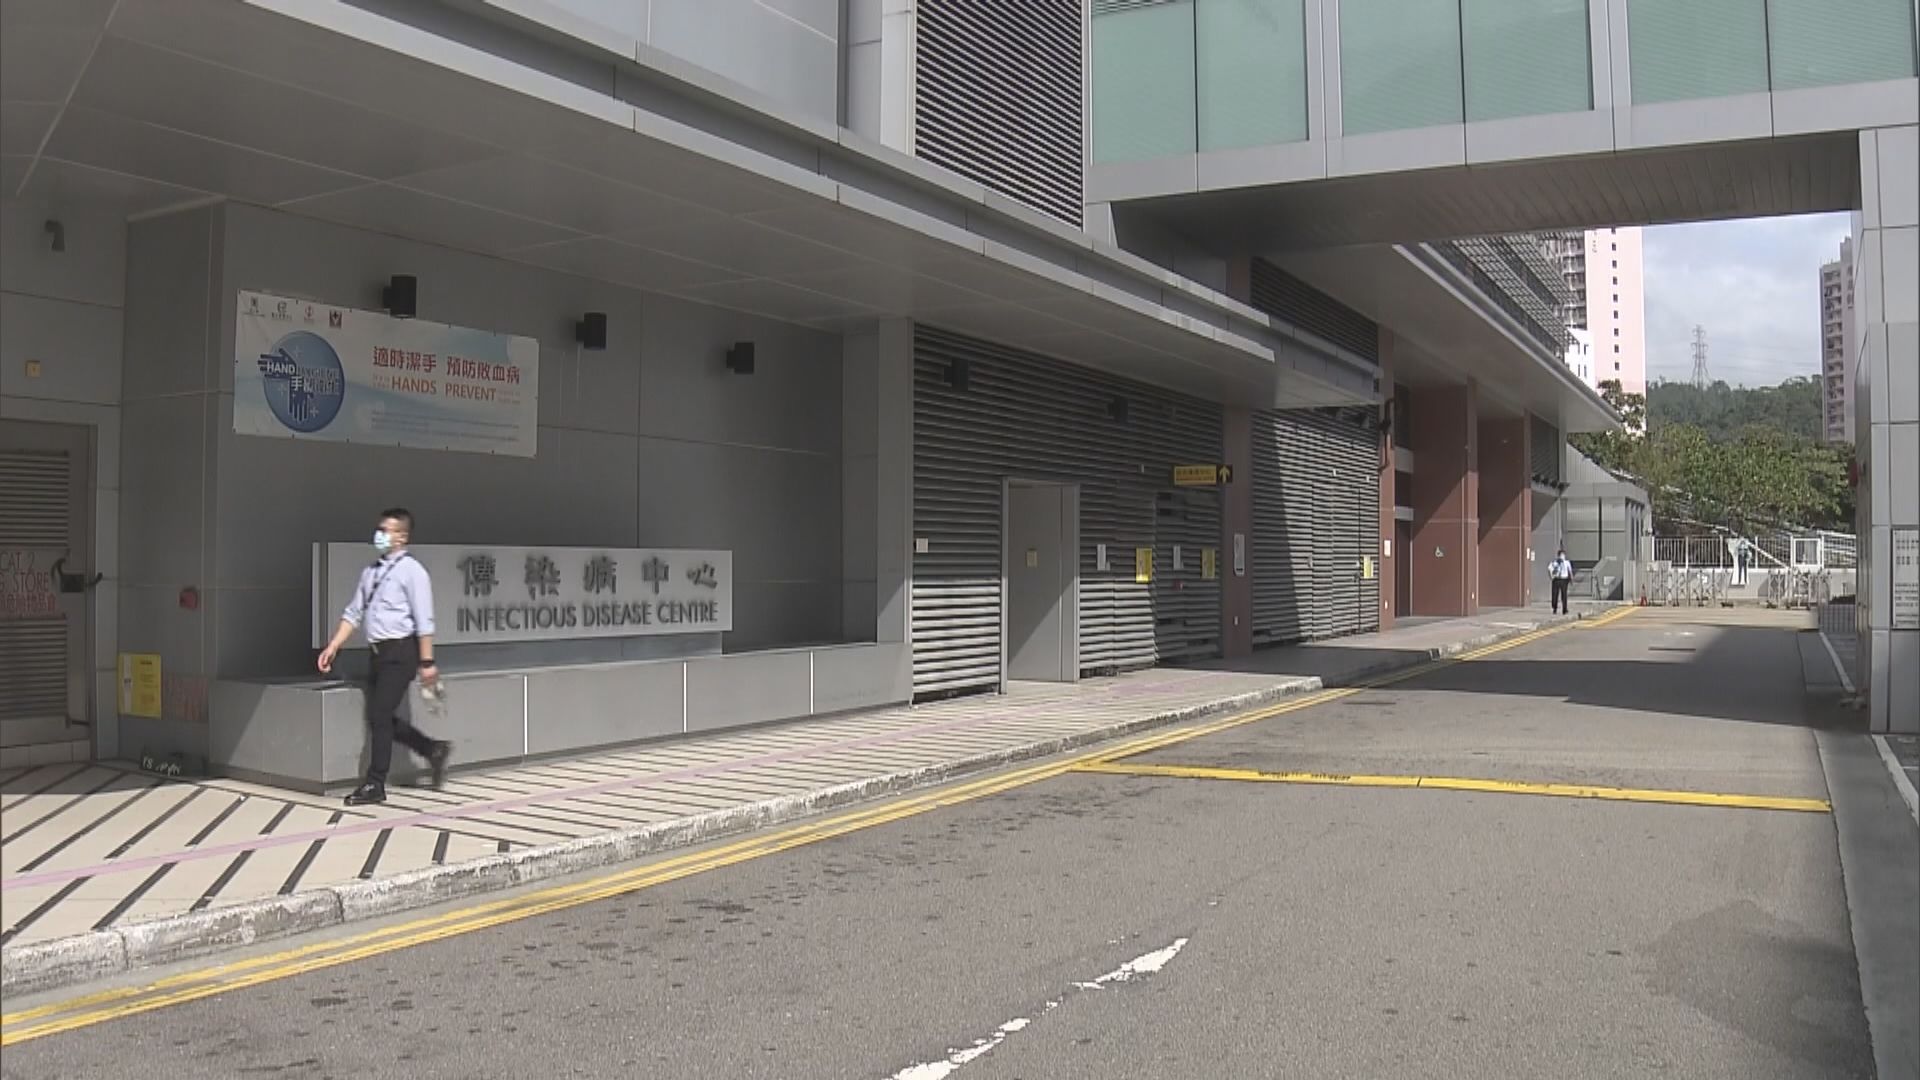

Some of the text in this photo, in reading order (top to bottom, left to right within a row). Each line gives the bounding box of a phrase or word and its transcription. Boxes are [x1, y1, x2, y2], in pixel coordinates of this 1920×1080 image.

[266, 361, 296, 375] HAND
[373, 346, 520, 384] 適時潔手 預防敗血病
[391, 376, 437, 395] HANDS
[445, 382, 496, 401] PREVENT
[13, 571, 49, 593] STORE
[456, 555, 718, 600] 傳染病中心
[457, 600, 719, 632] INFECTIOUS DISEASE CENTRE
